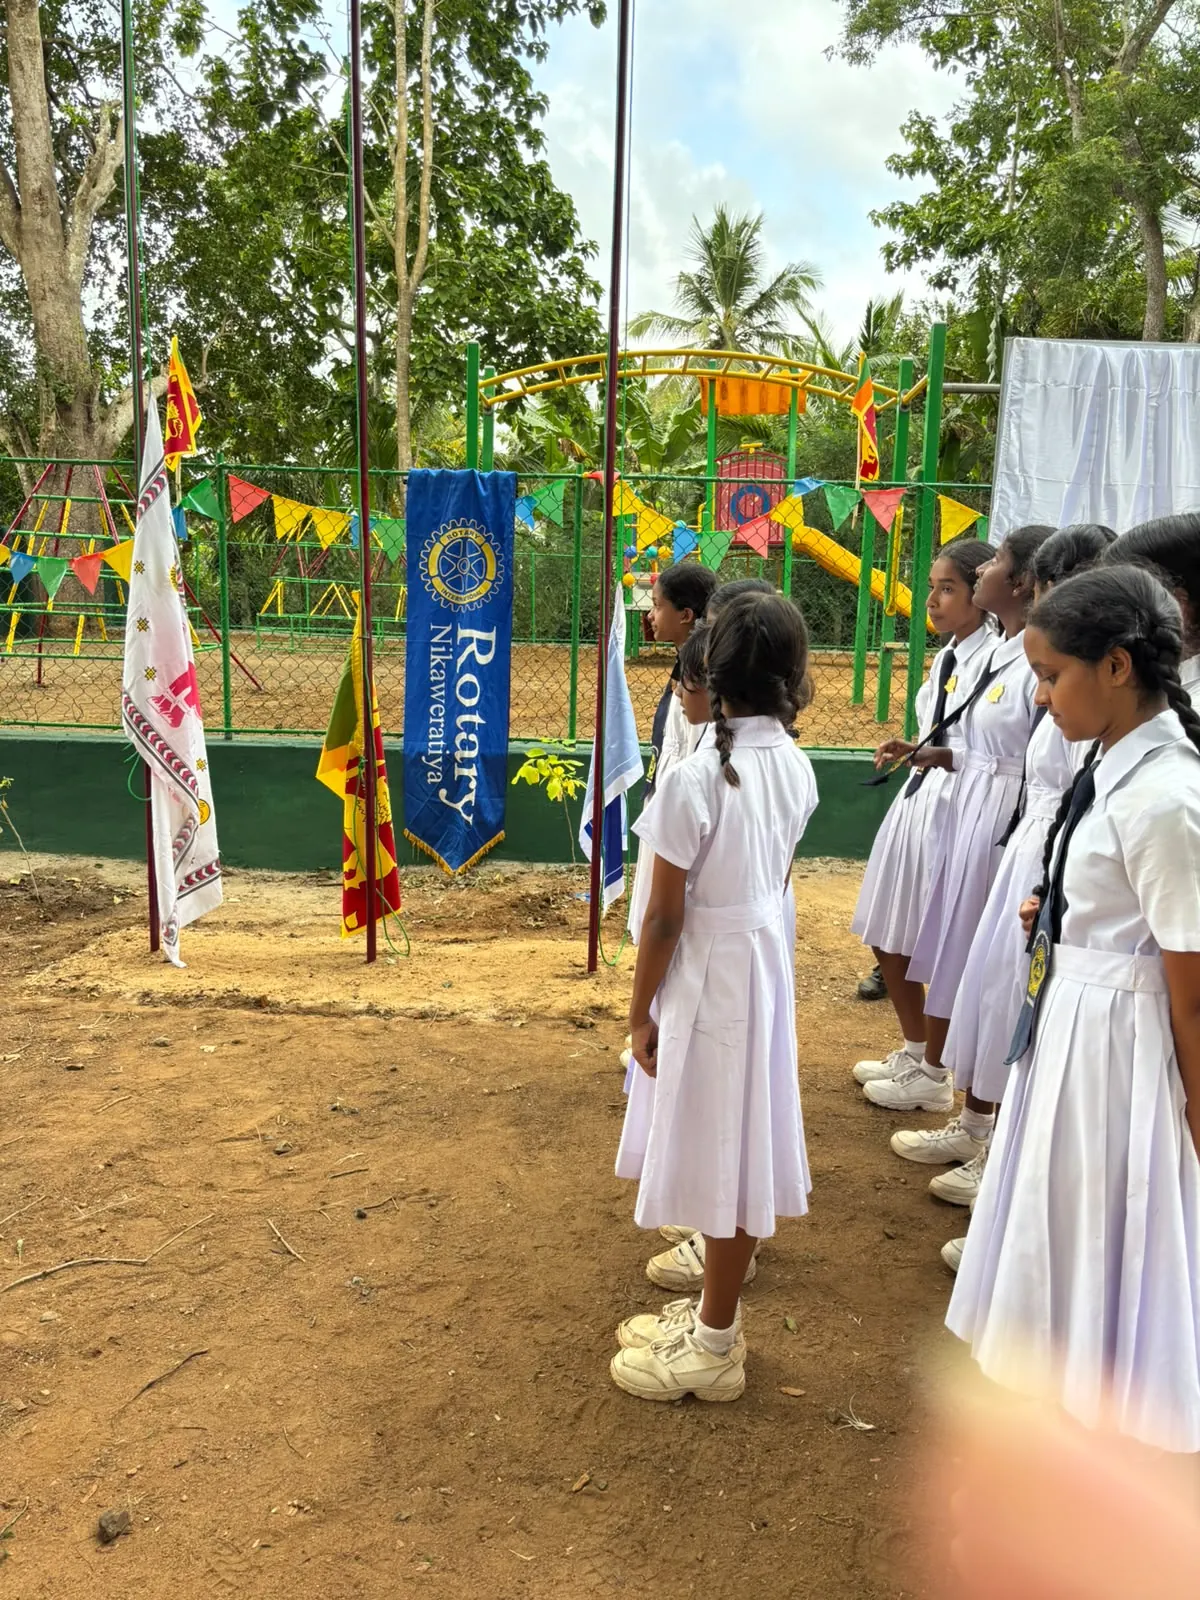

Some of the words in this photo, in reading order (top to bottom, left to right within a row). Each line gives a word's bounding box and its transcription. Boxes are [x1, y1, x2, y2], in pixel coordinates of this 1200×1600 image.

[446, 530, 481, 541] ROTARY
[421, 623, 453, 785] Nikaweratiya
[438, 623, 497, 825] Rotary
